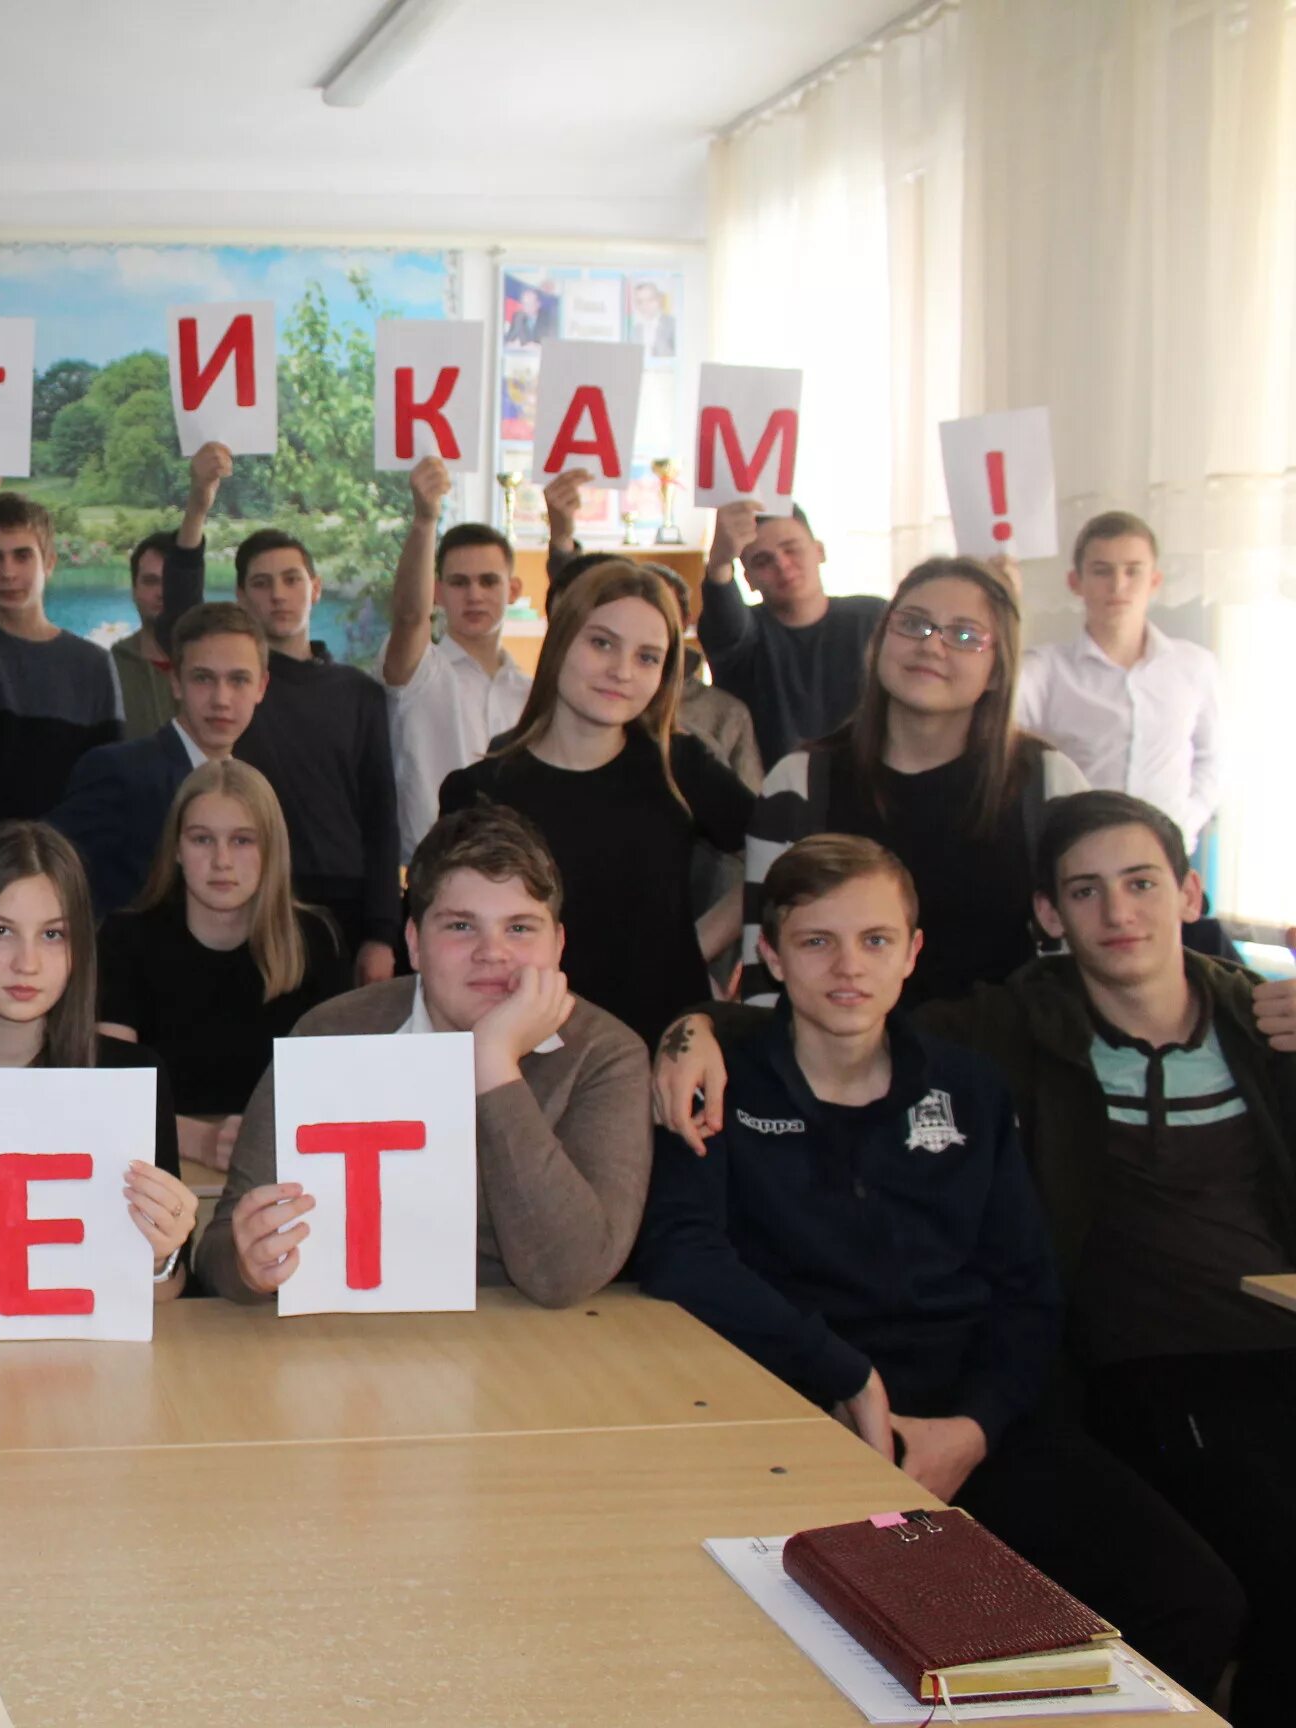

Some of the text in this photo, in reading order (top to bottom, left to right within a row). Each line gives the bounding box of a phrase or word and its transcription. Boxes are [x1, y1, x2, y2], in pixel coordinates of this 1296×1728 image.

[178, 313, 257, 412] И
[394, 365, 461, 460] К
[543, 384, 622, 479] А
[697, 405, 797, 496] М
[985, 450, 1013, 542] !
[295, 1120, 427, 1291] Т
